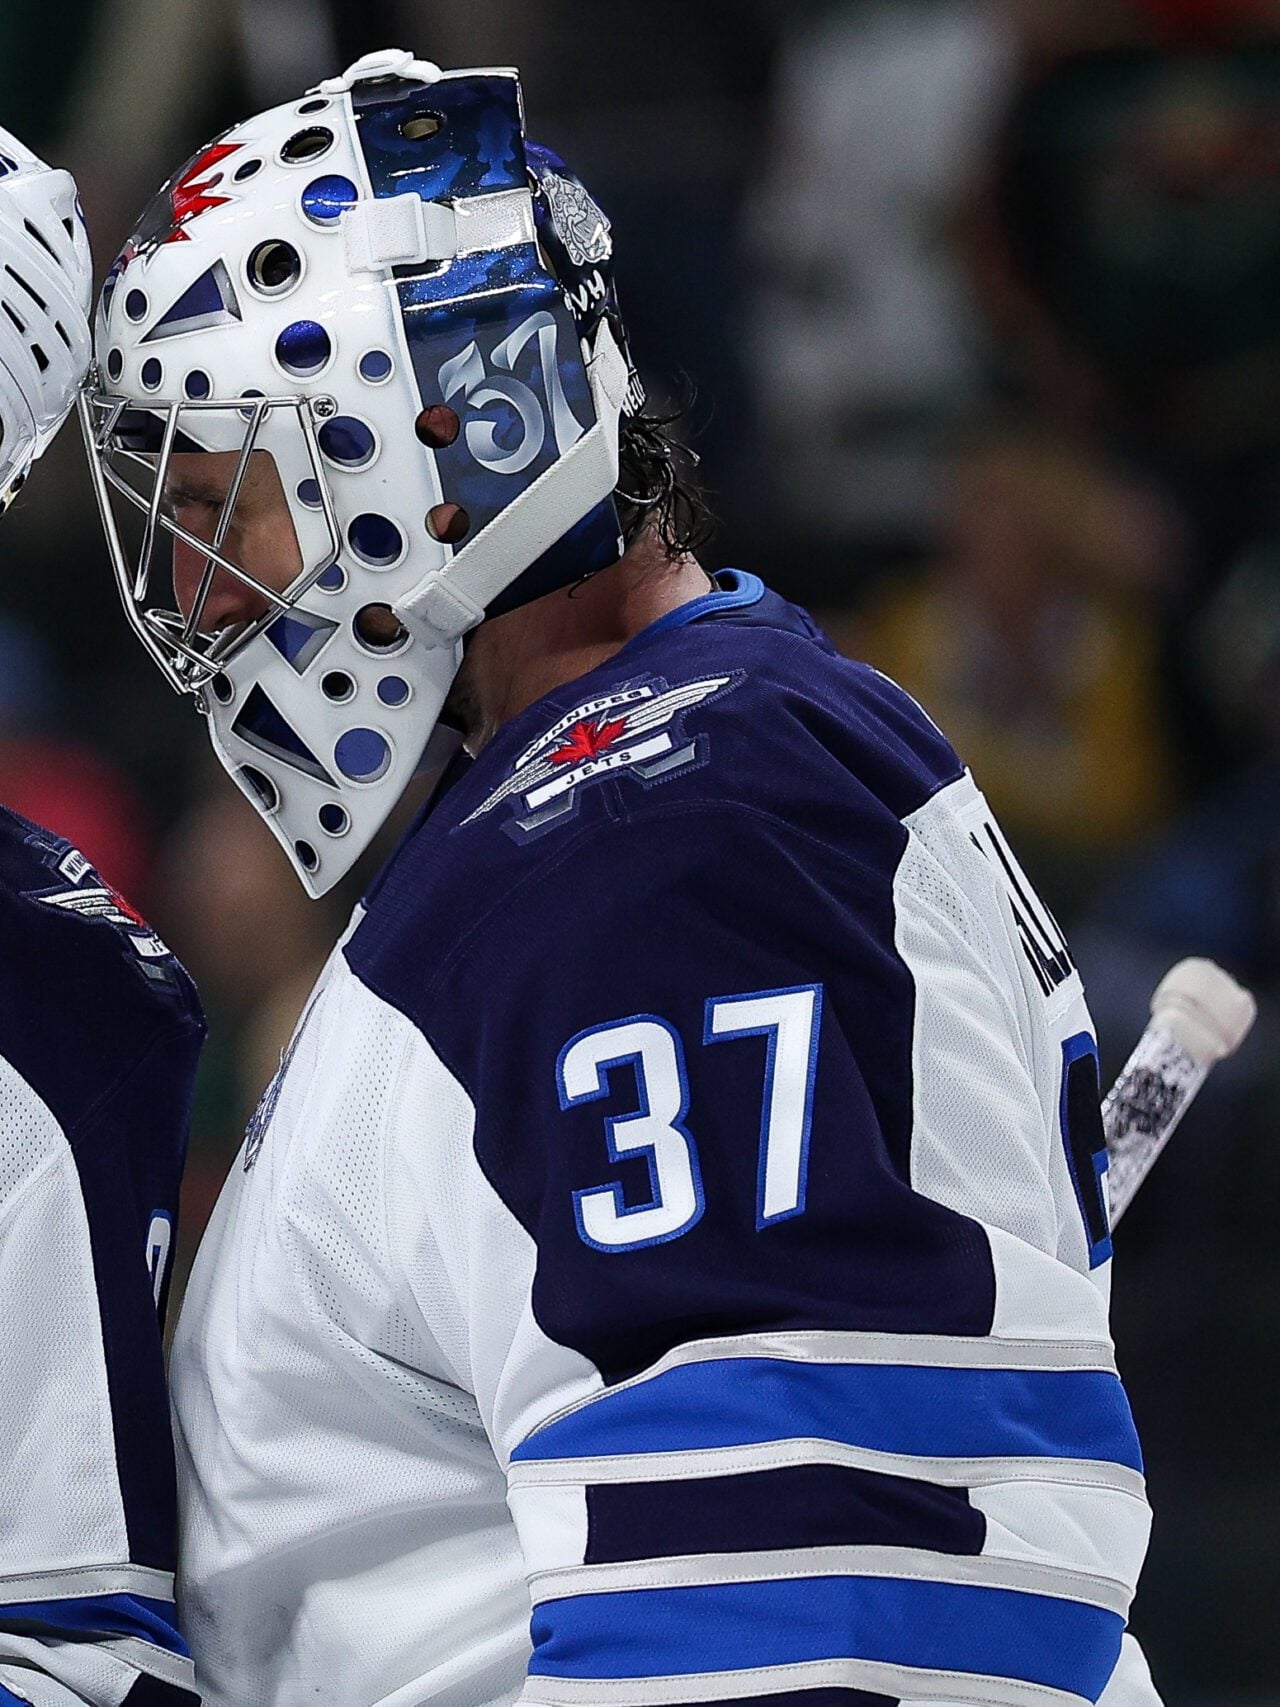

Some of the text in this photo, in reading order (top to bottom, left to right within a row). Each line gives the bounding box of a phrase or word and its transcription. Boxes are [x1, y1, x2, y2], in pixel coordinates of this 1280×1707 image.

[438, 310, 585, 475] 37
[524, 689, 643, 760] WINNIPEG
[565, 750, 632, 786] JETS
[555, 982, 824, 1254] 37
